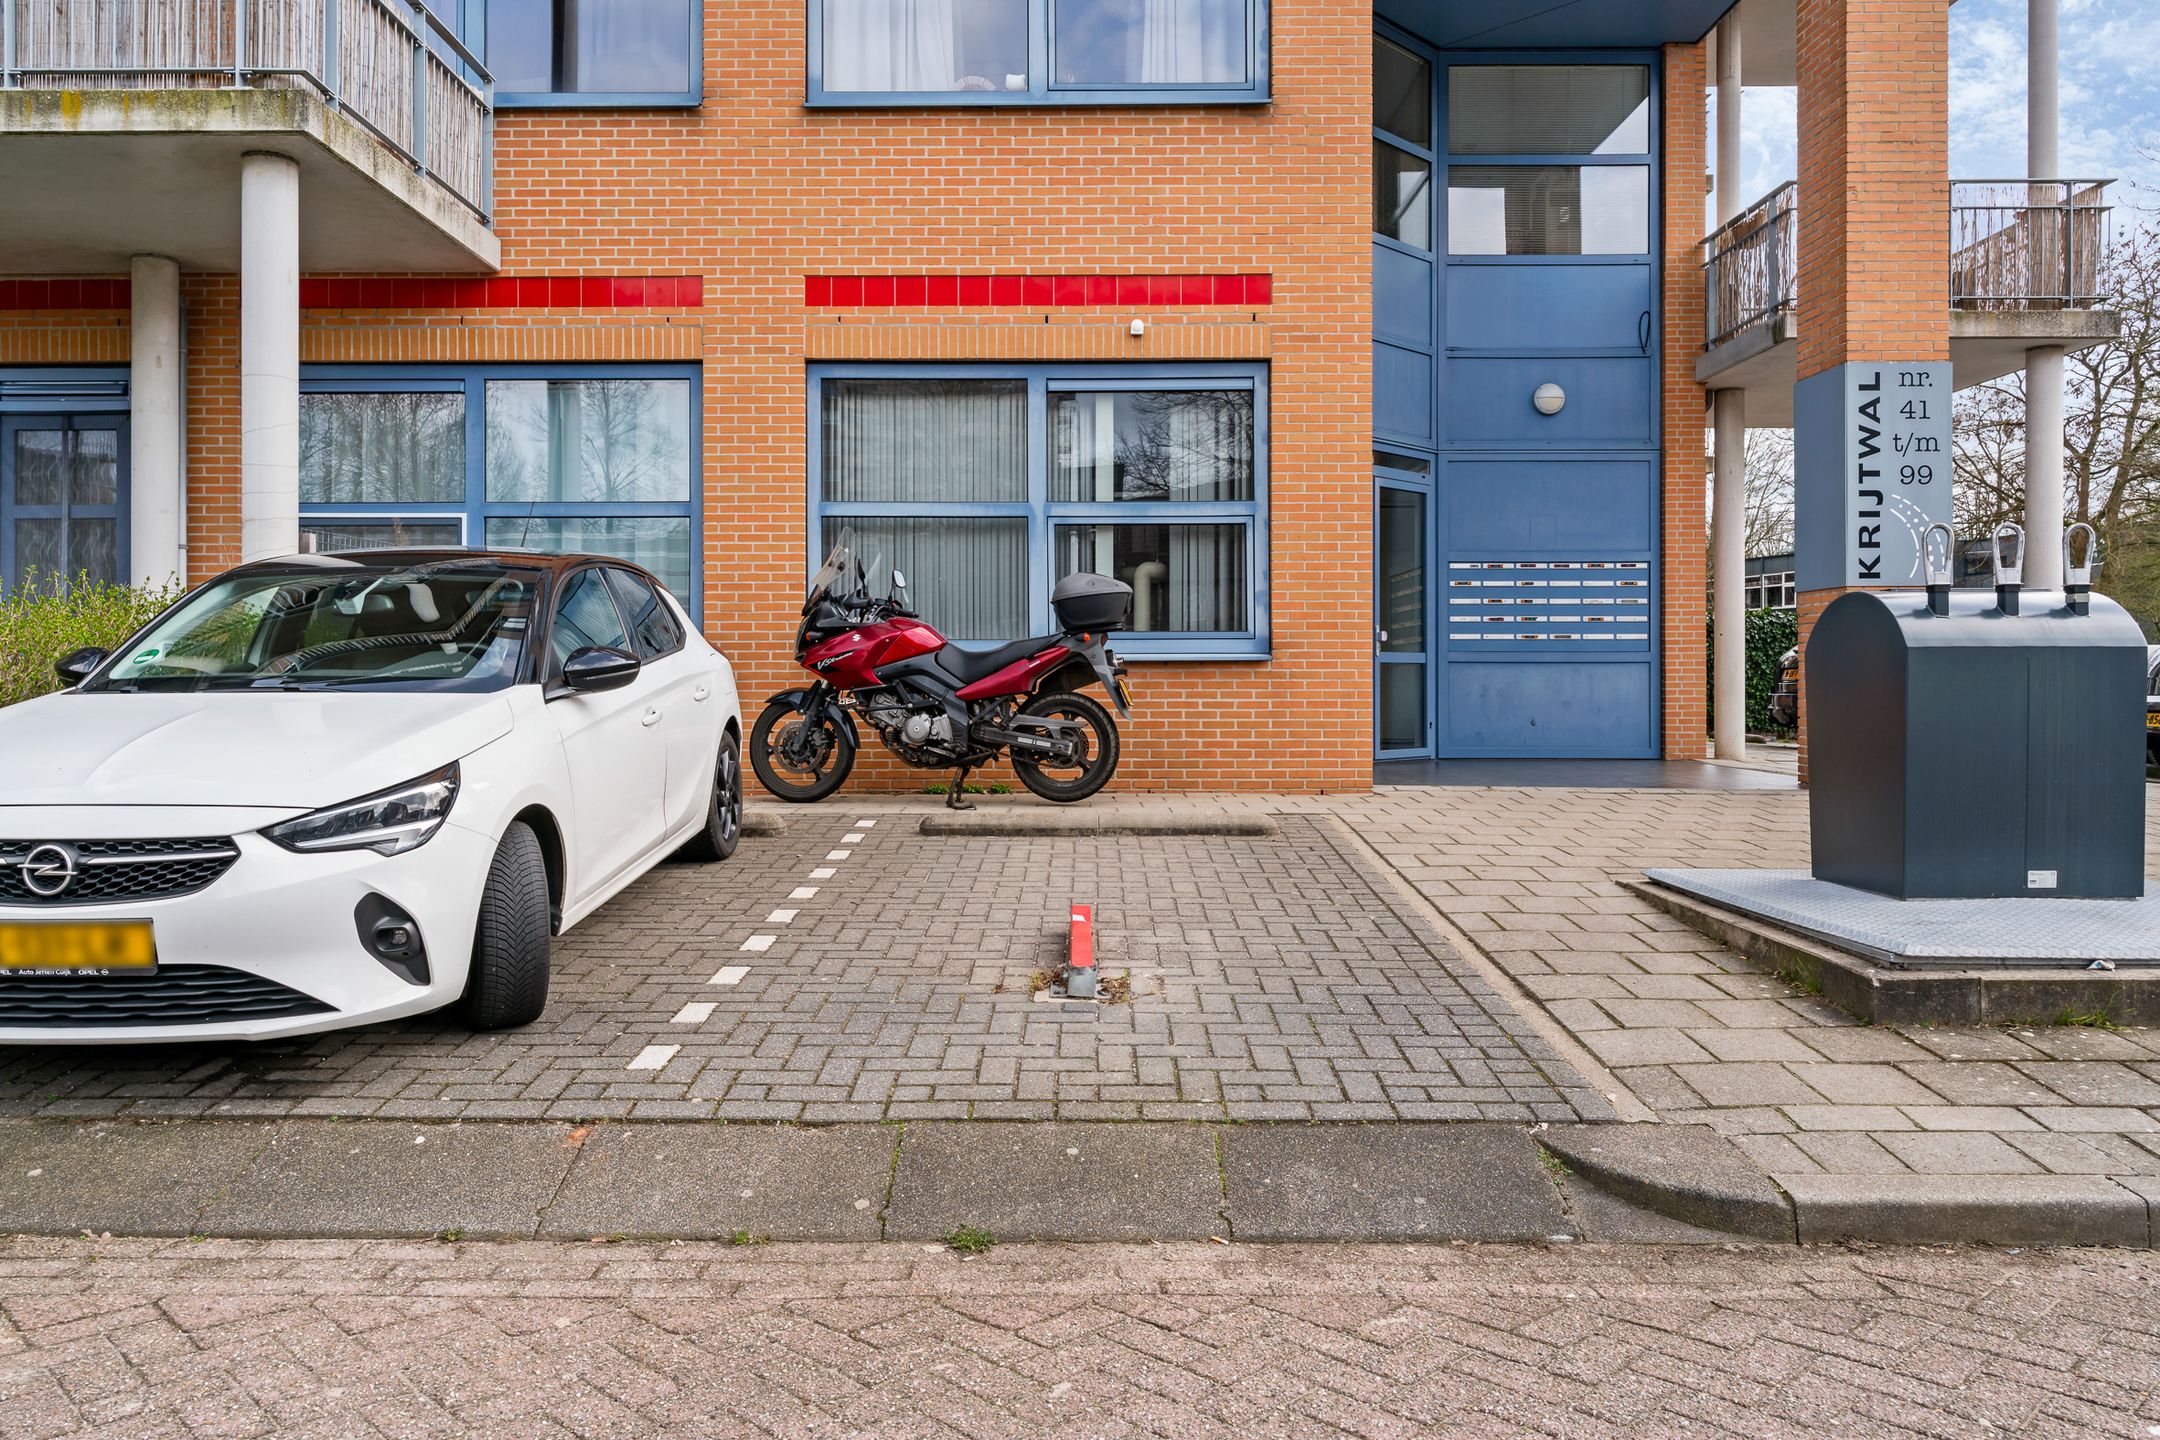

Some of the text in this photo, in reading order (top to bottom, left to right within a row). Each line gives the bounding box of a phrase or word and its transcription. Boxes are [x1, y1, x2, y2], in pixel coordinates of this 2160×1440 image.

[1898, 371, 1933, 387] nr.
[1899, 400, 1930, 419] 41
[1892, 432, 1940, 457] t/m
[1858, 371, 1883, 579] KRIJTWAL
[1899, 464, 1933, 485] 99
